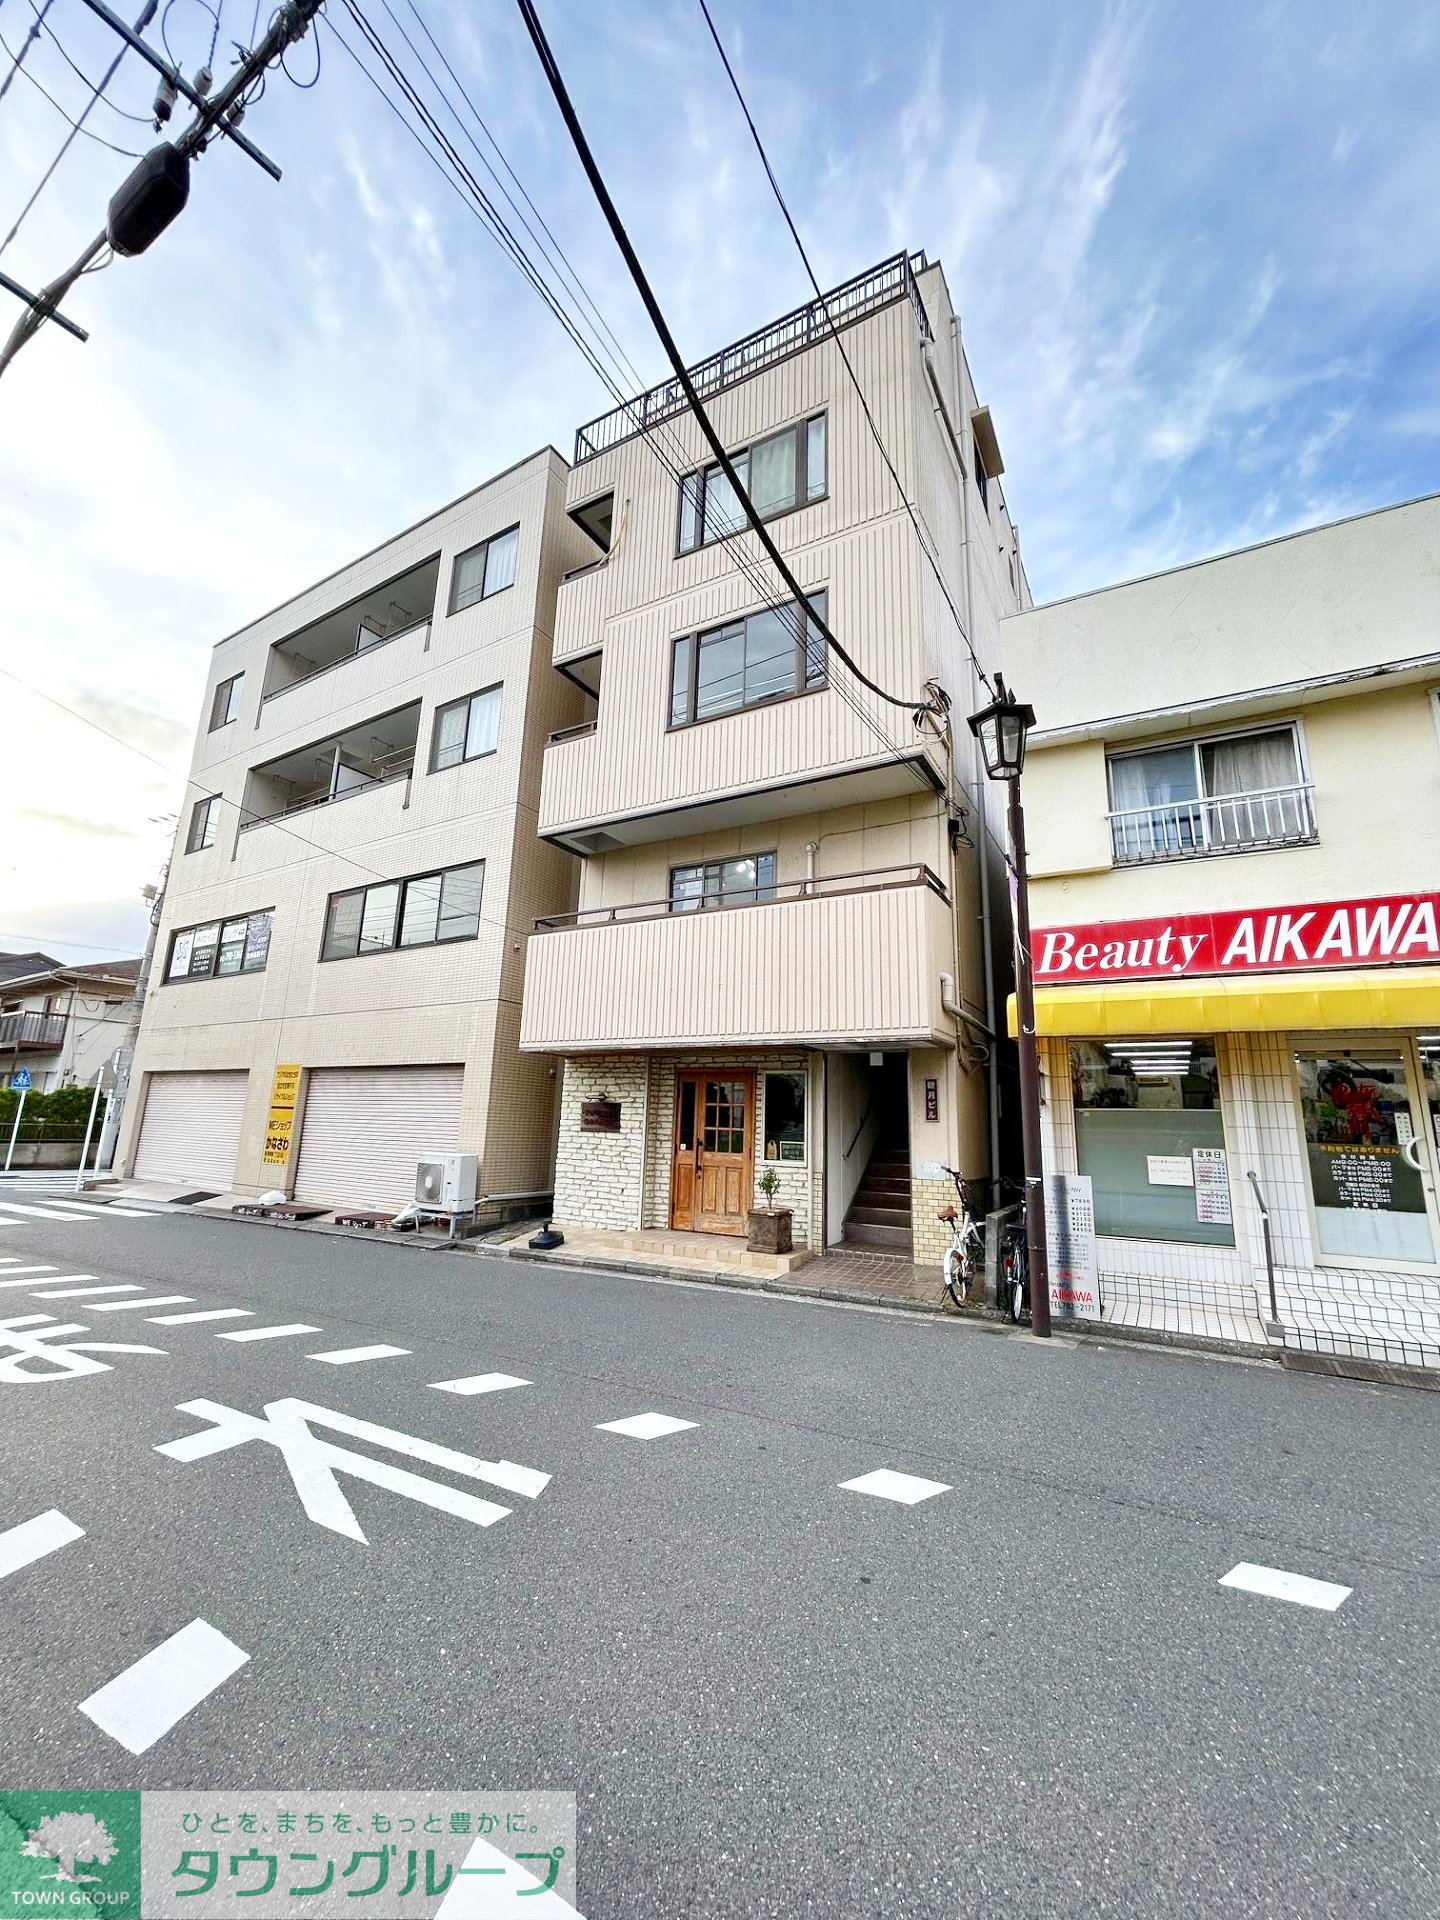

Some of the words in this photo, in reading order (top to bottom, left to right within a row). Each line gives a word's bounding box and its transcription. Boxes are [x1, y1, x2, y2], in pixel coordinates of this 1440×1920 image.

[1035, 926, 1209, 975] Beauty
[1220, 901, 1440, 966] AIKAWA
[265, 1136, 290, 1151] かなざわ
[1197, 1150, 1221, 1158] 定休日
